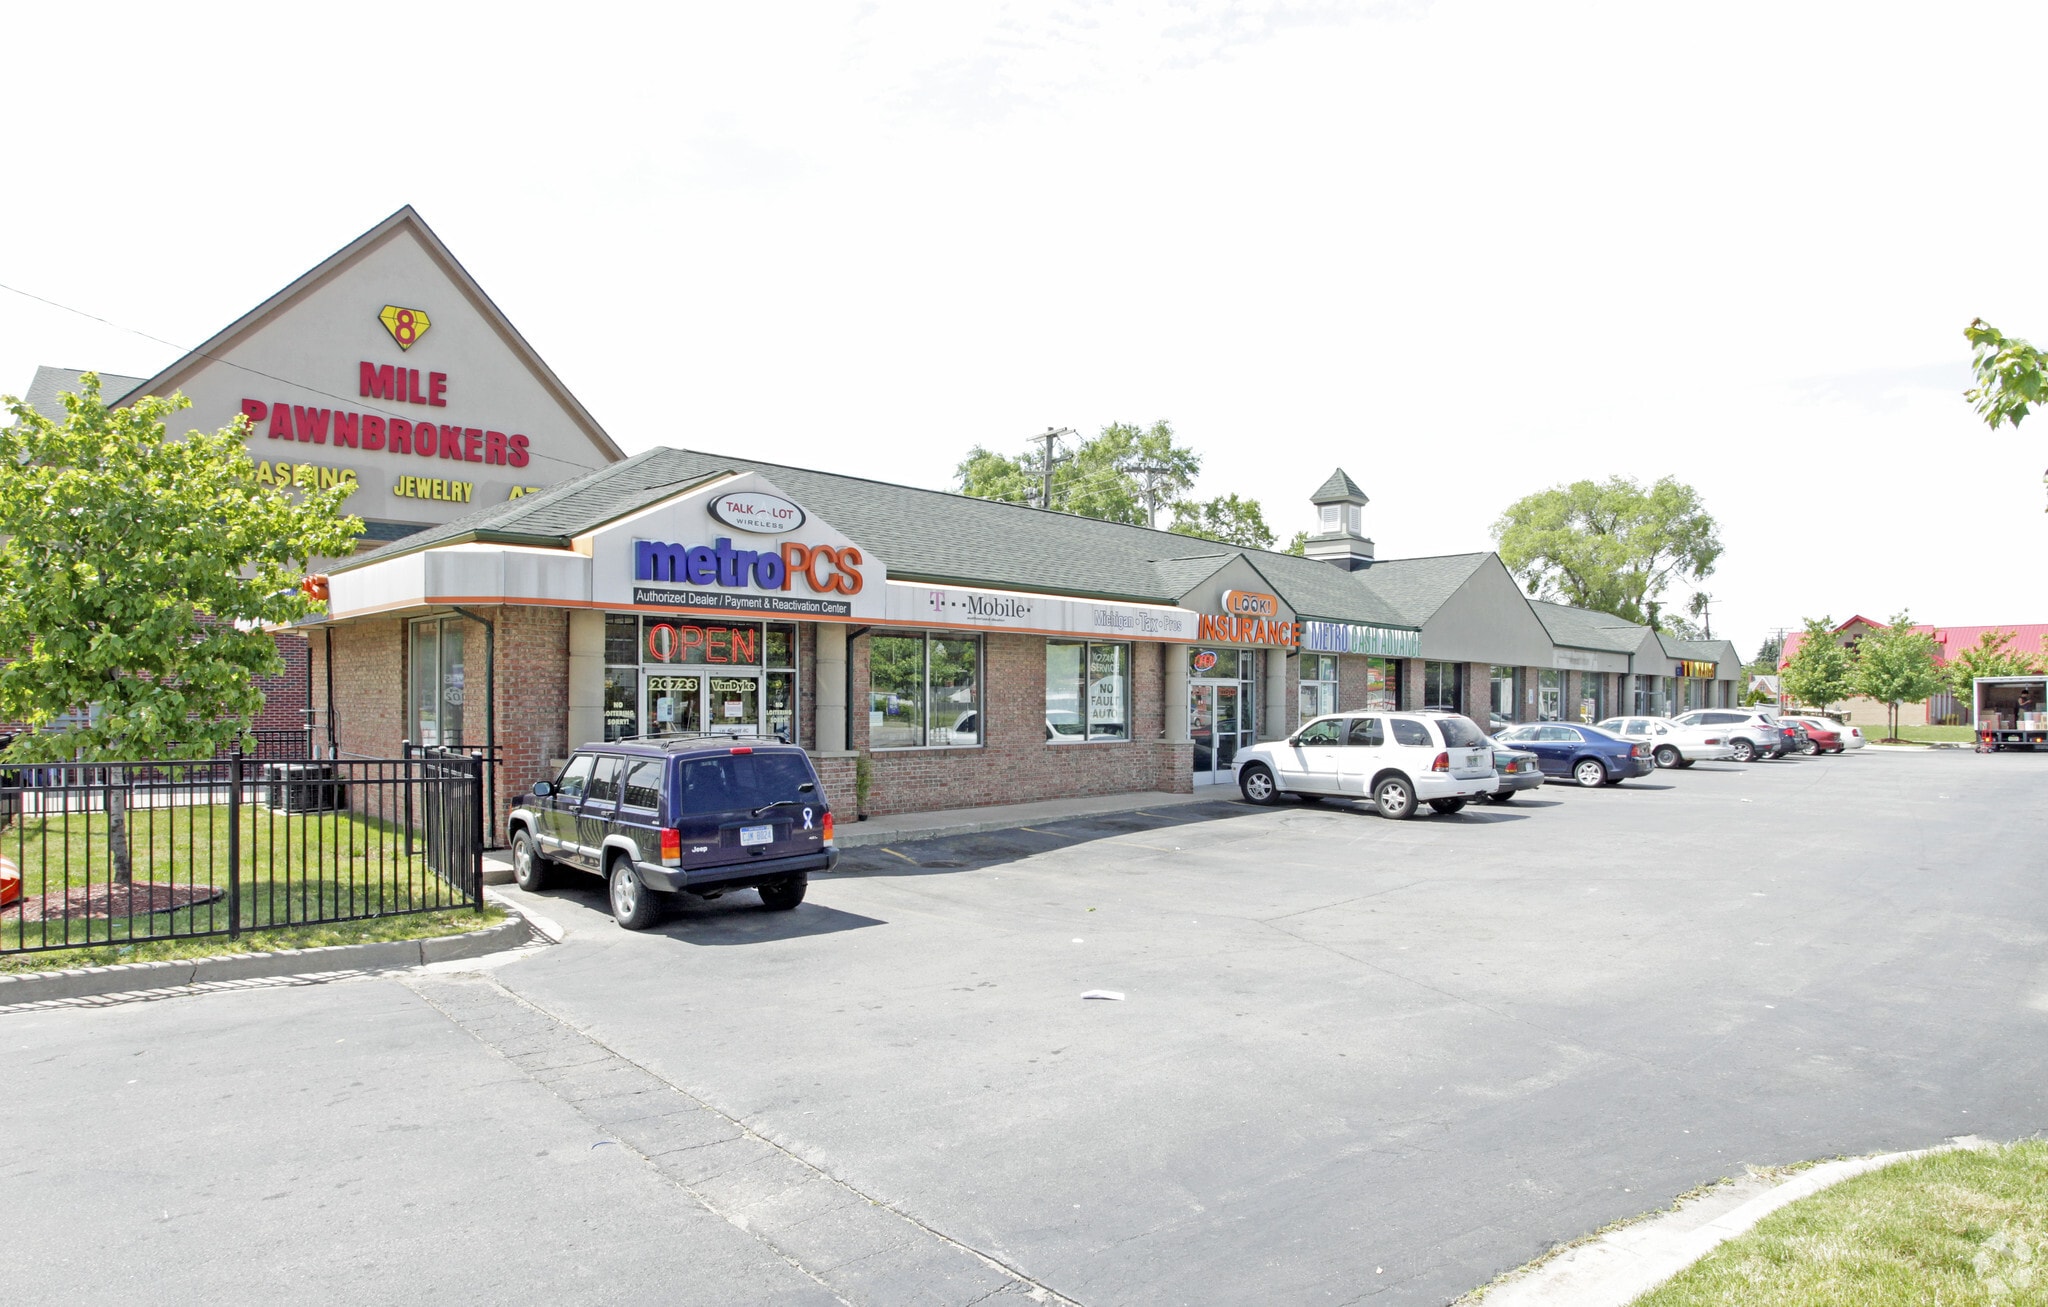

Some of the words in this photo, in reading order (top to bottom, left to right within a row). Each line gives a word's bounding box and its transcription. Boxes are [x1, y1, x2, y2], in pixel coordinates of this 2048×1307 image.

[395, 309, 416, 345] 8
[359, 361, 448, 407] MILE
[241, 398, 530, 468] PAWNBROKERS
[239, 460, 357, 489] ASHING
[393, 475, 474, 504] JEWELRY
[726, 501, 754, 515] TALK
[772, 508, 794, 520] LOT
[736, 518, 784, 529] WIRELESS
[634, 537, 863, 596] metroPCS
[636, 589, 686, 604] Authorized
[688, 593, 718, 606] Dealer
[725, 596, 762, 609] Payment
[764, 598, 770, 609] &
[772, 598, 820, 612] Reactivation
[821, 602, 847, 614] Center
[1234, 595, 1271, 613] LOOK!
[1094, 610, 1134, 631] Michigan
[1139, 612, 1158, 632] Tax
[1163, 615, 1183, 632] Pros
[1199, 613, 1302, 647] INSURANCE
[649, 623, 755, 663] OPEN
[1311, 621, 1349, 652] METRO
[1351, 625, 1379, 654] CASH
[1380, 629, 1422, 657] ADVANCE
[1091, 663, 1120, 673] SERVICE
[648, 678, 698, 691] 20723
[711, 679, 756, 693] VanDyke
[1100, 684, 1114, 694] NO
[1091, 696, 1120, 706] FAULT
[1092, 708, 1118, 719] AUTO
